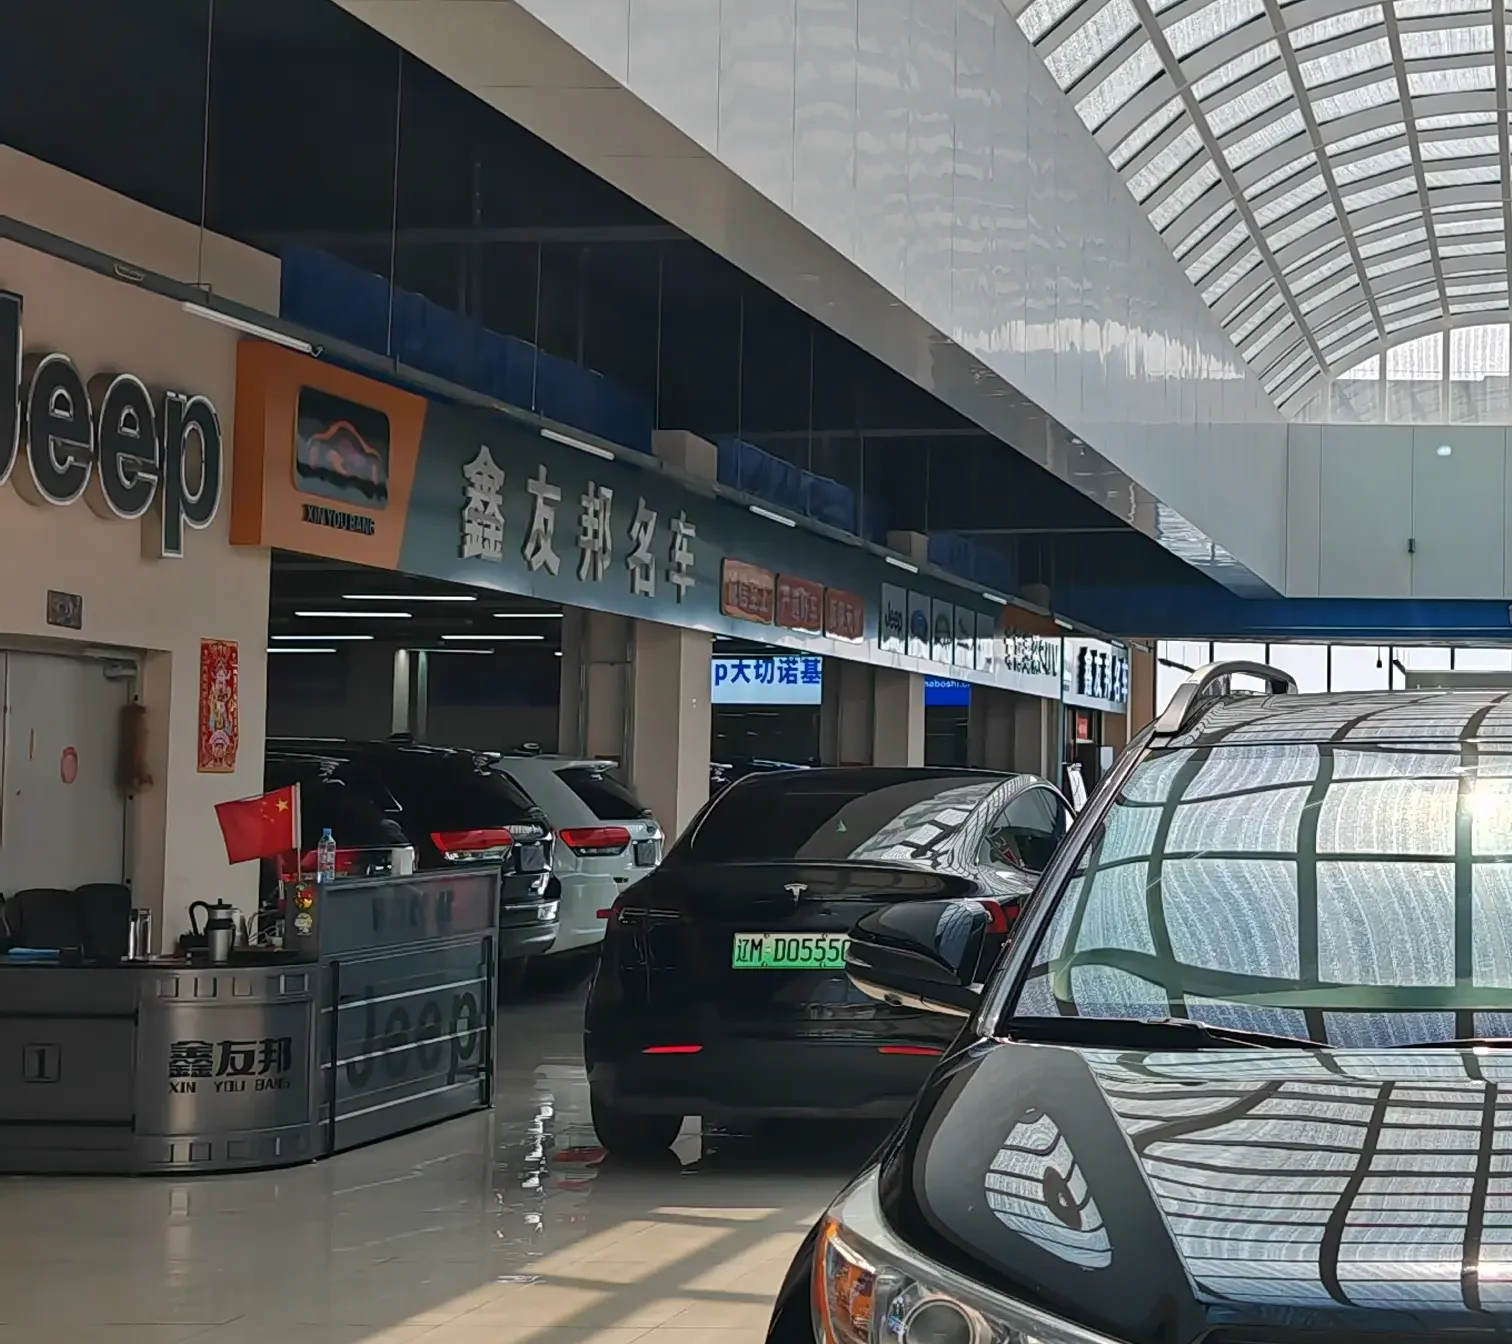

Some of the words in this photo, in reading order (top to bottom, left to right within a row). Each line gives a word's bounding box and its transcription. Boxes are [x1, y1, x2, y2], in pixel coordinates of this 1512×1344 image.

[462, 445, 696, 603] 鑫友邦名车
[168, 1037, 292, 1078] 鑫友邦
[168, 1081, 197, 1094] XIN
[213, 1080, 246, 1093] YOU
